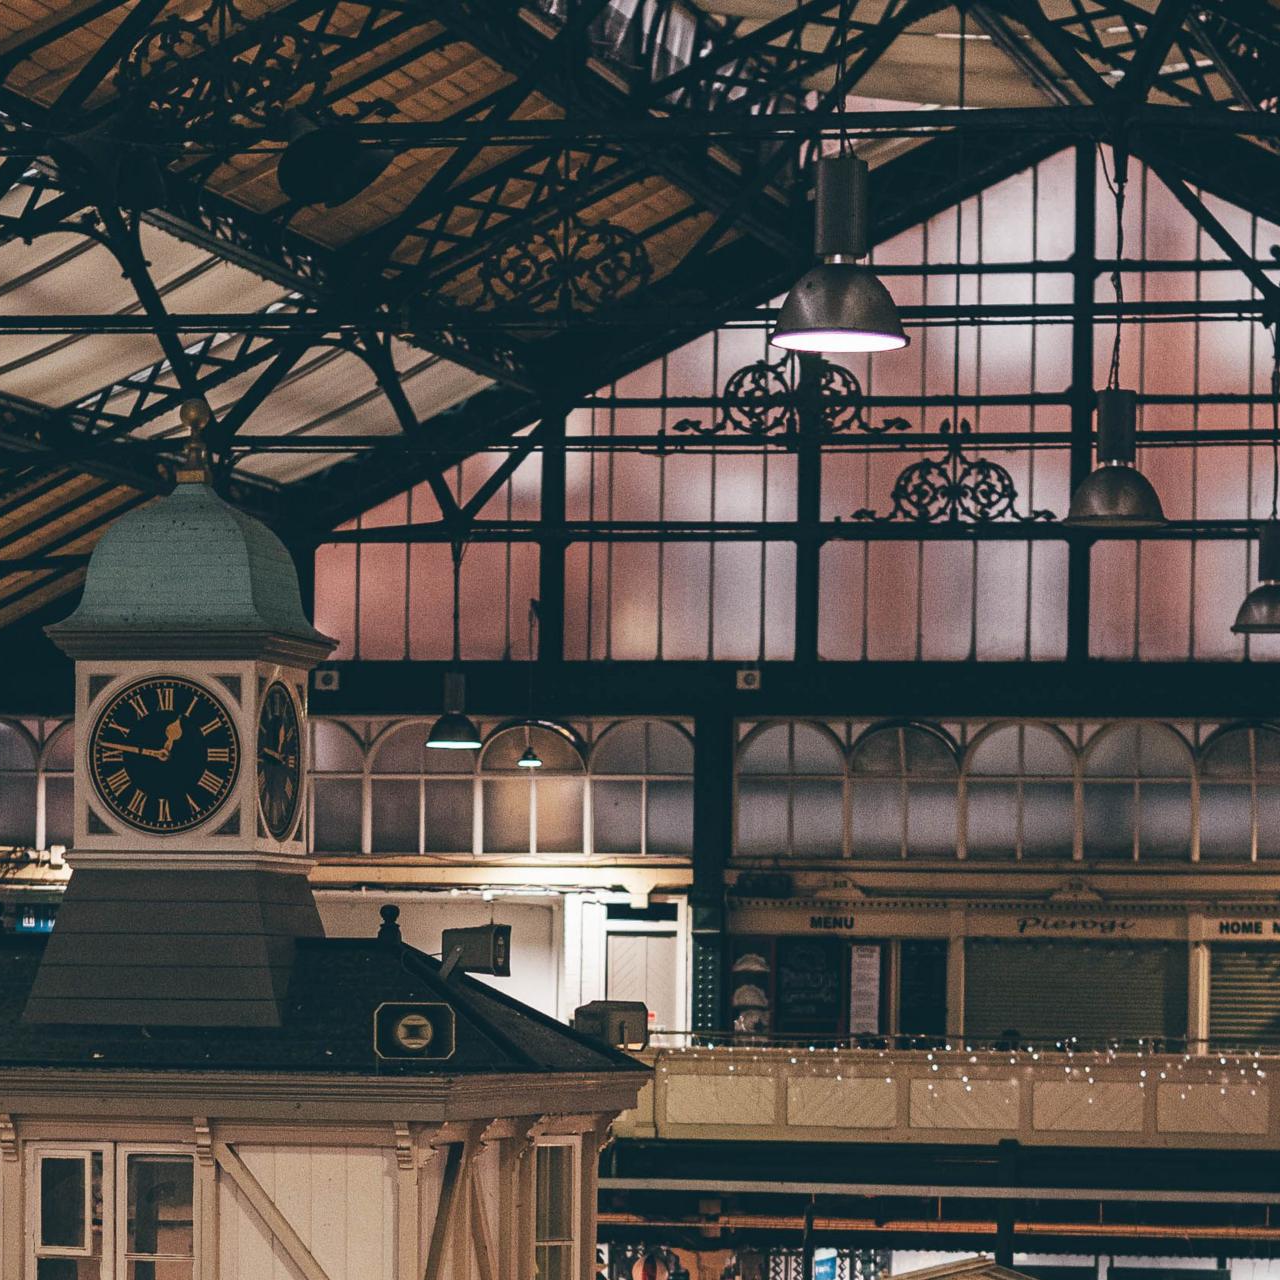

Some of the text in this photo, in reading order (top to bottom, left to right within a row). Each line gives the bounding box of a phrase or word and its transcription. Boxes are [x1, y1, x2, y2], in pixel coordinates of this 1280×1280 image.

[810, 916, 854, 929] MENU
[1017, 916, 1135, 933] Pierogi
[1220, 920, 1263, 935] HOME
